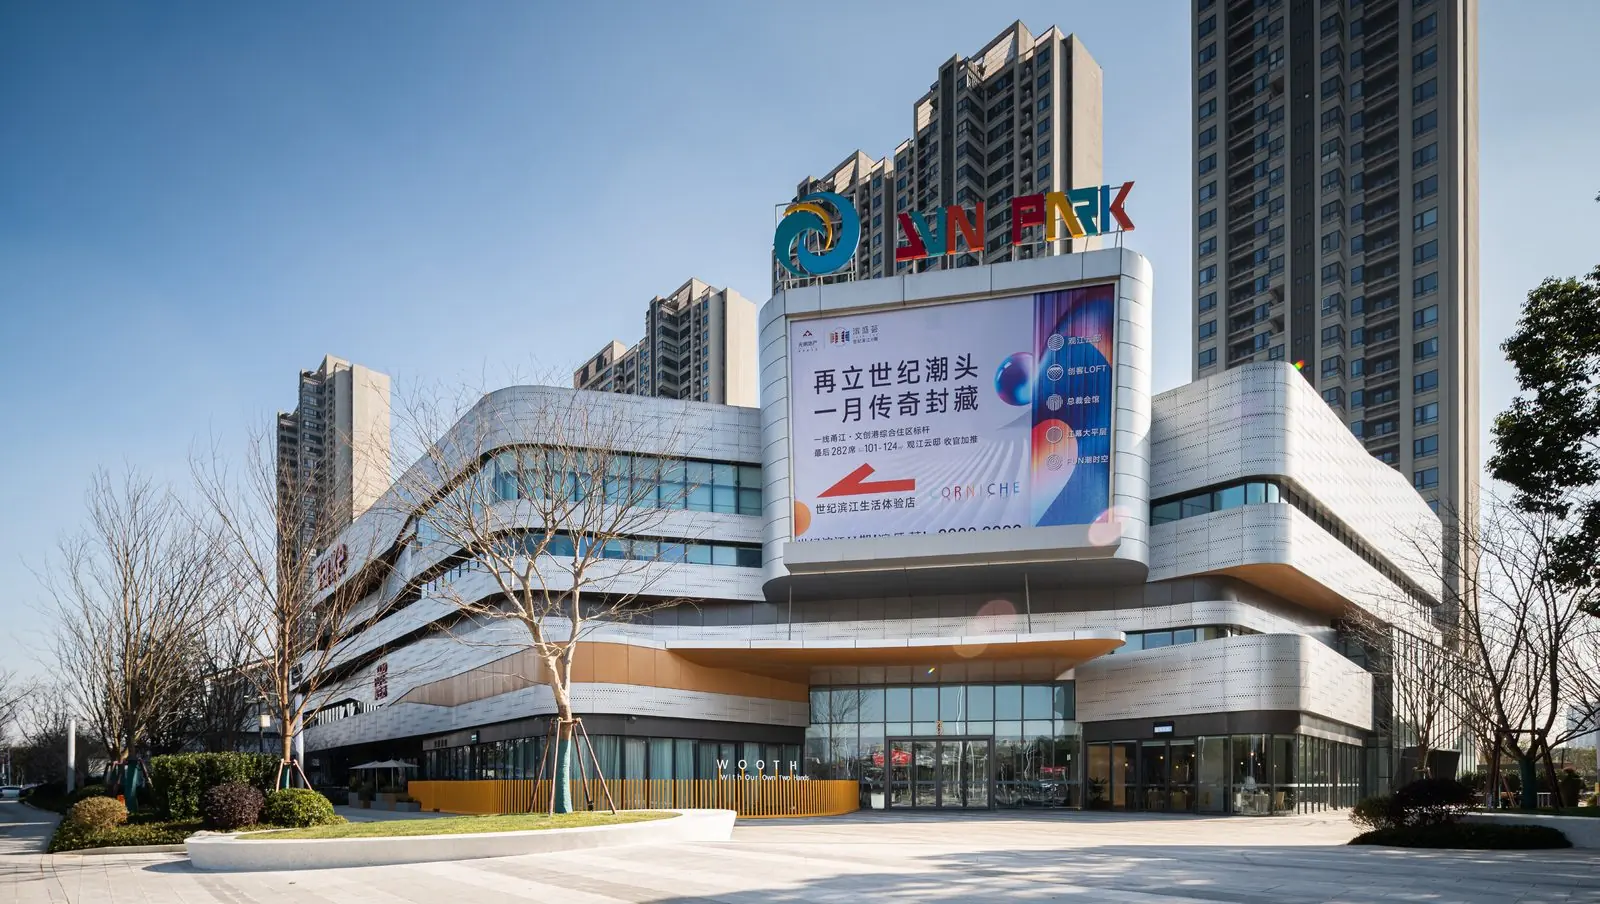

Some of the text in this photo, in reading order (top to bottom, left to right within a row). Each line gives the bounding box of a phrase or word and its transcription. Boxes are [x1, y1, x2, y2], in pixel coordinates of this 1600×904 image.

[1011, 181, 1136, 247] PARK
[813, 352, 979, 395] 再立世纪潮头
[813, 384, 979, 424] 一月传奇封藏
[929, 481, 1021, 500] CORNICHE
[815, 496, 916, 516] 世纪滨江生活体验店
[716, 759, 798, 770] WOOTH
